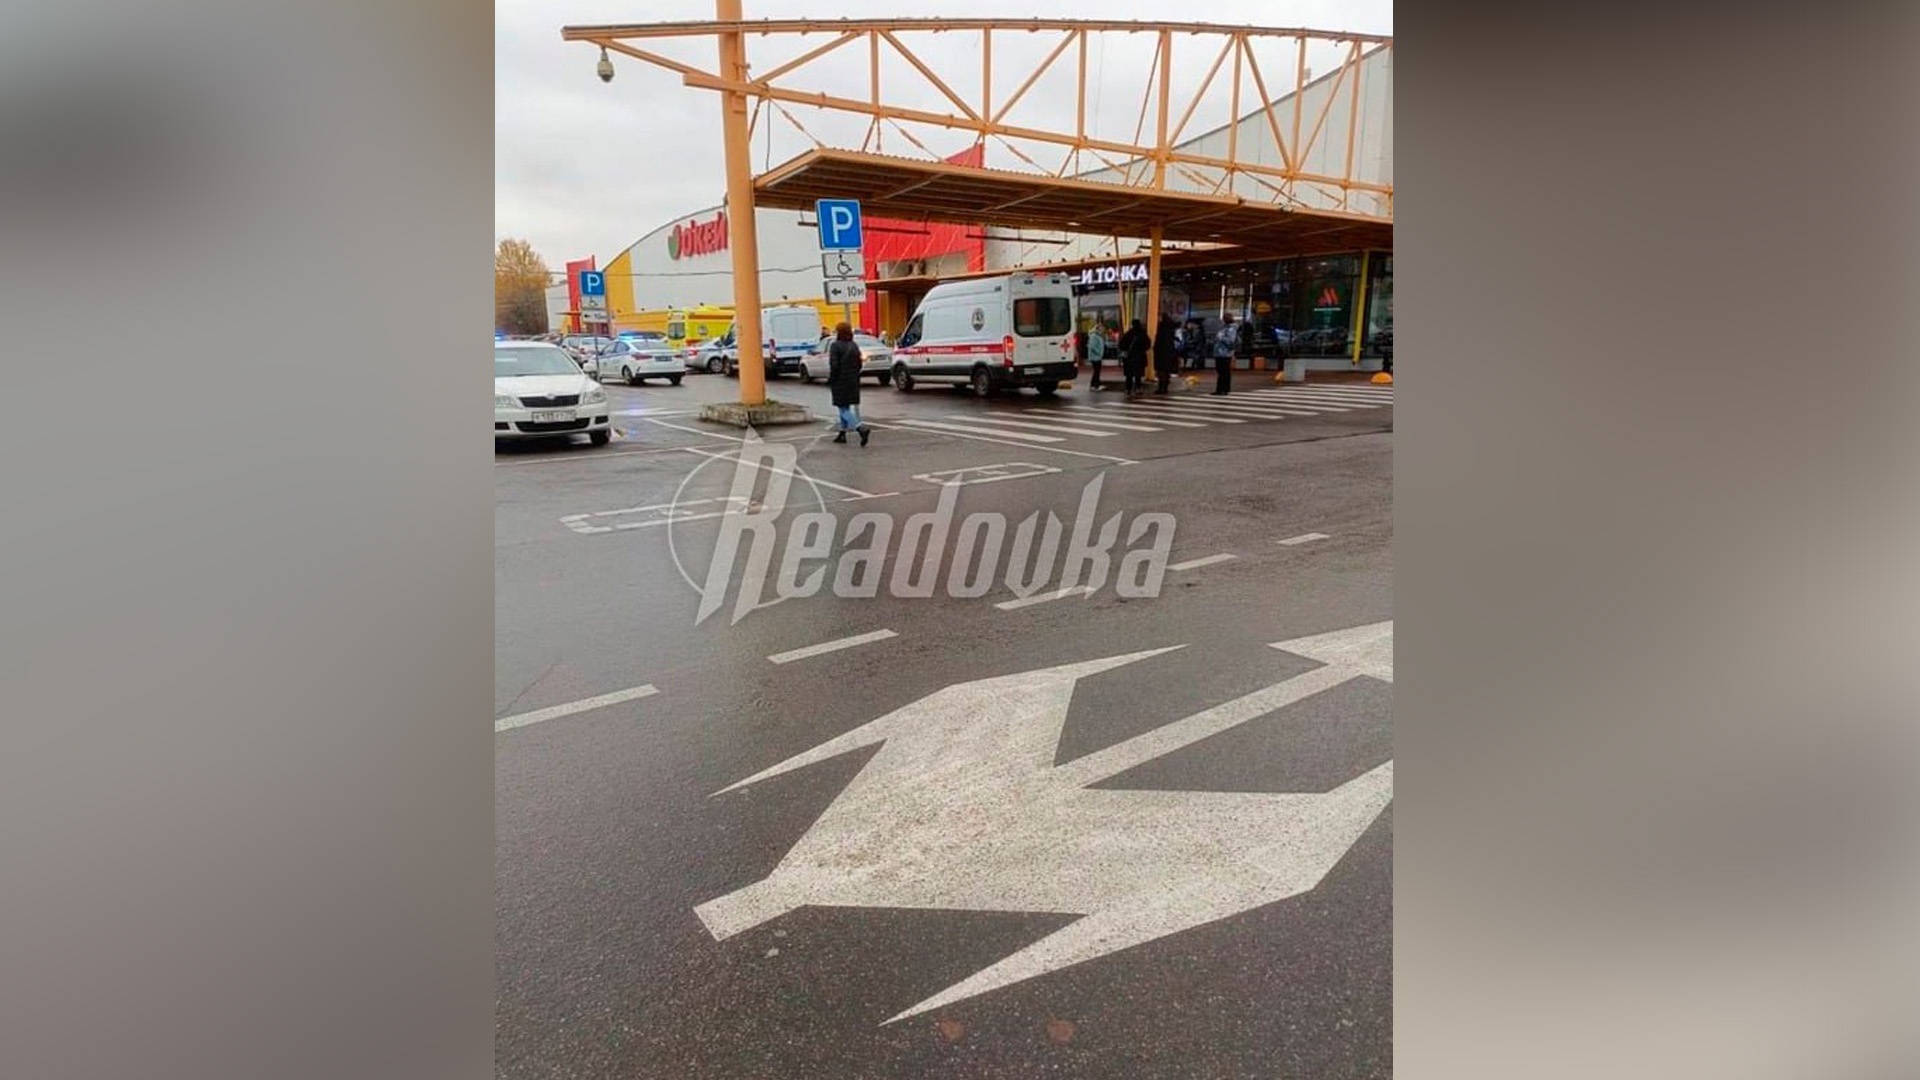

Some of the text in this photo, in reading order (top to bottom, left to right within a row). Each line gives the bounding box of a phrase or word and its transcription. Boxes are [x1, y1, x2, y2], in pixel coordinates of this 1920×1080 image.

[831, 206, 853, 244] P
[586, 273, 600, 293] P
[1081, 268, 1093, 284] И
[1095, 264, 1148, 283] ТОЧКА
